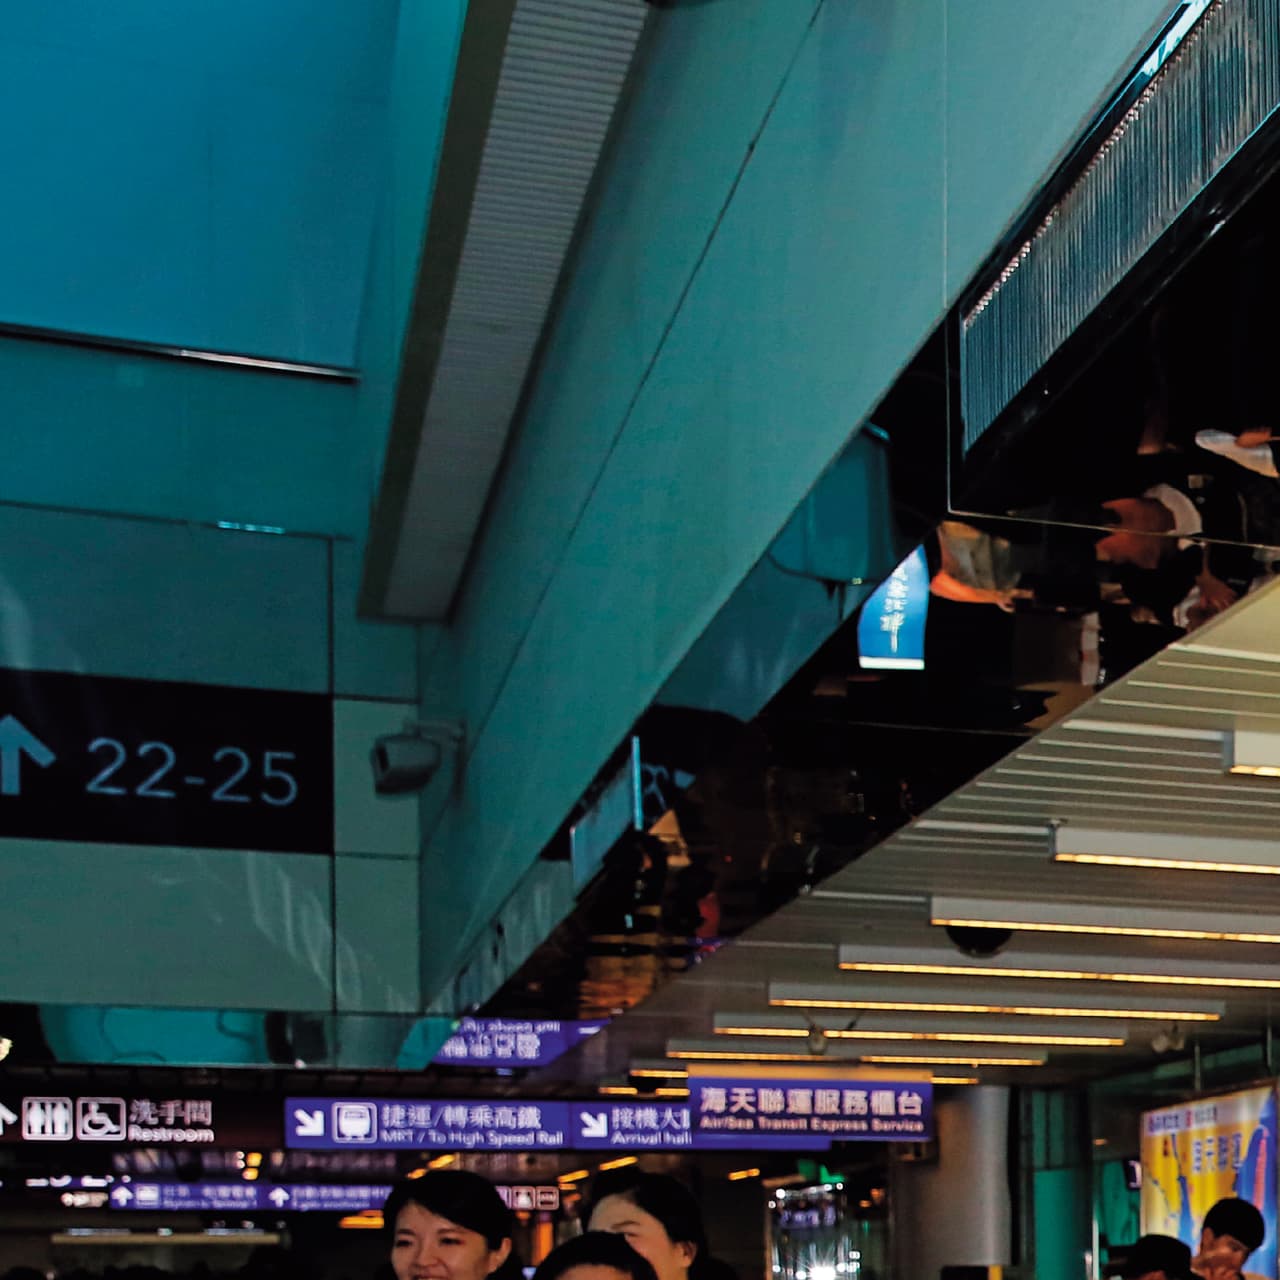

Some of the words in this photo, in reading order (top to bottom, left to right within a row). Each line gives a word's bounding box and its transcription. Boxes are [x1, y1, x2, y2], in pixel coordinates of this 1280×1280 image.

[86, 737, 298, 805] 22-25
[129, 1100, 213, 1126] 洗手間
[700, 1087, 923, 1116] 海天聯運服務櫃台
[612, 1107, 691, 1130] 接機大
[872, 1119, 924, 1133] Service
